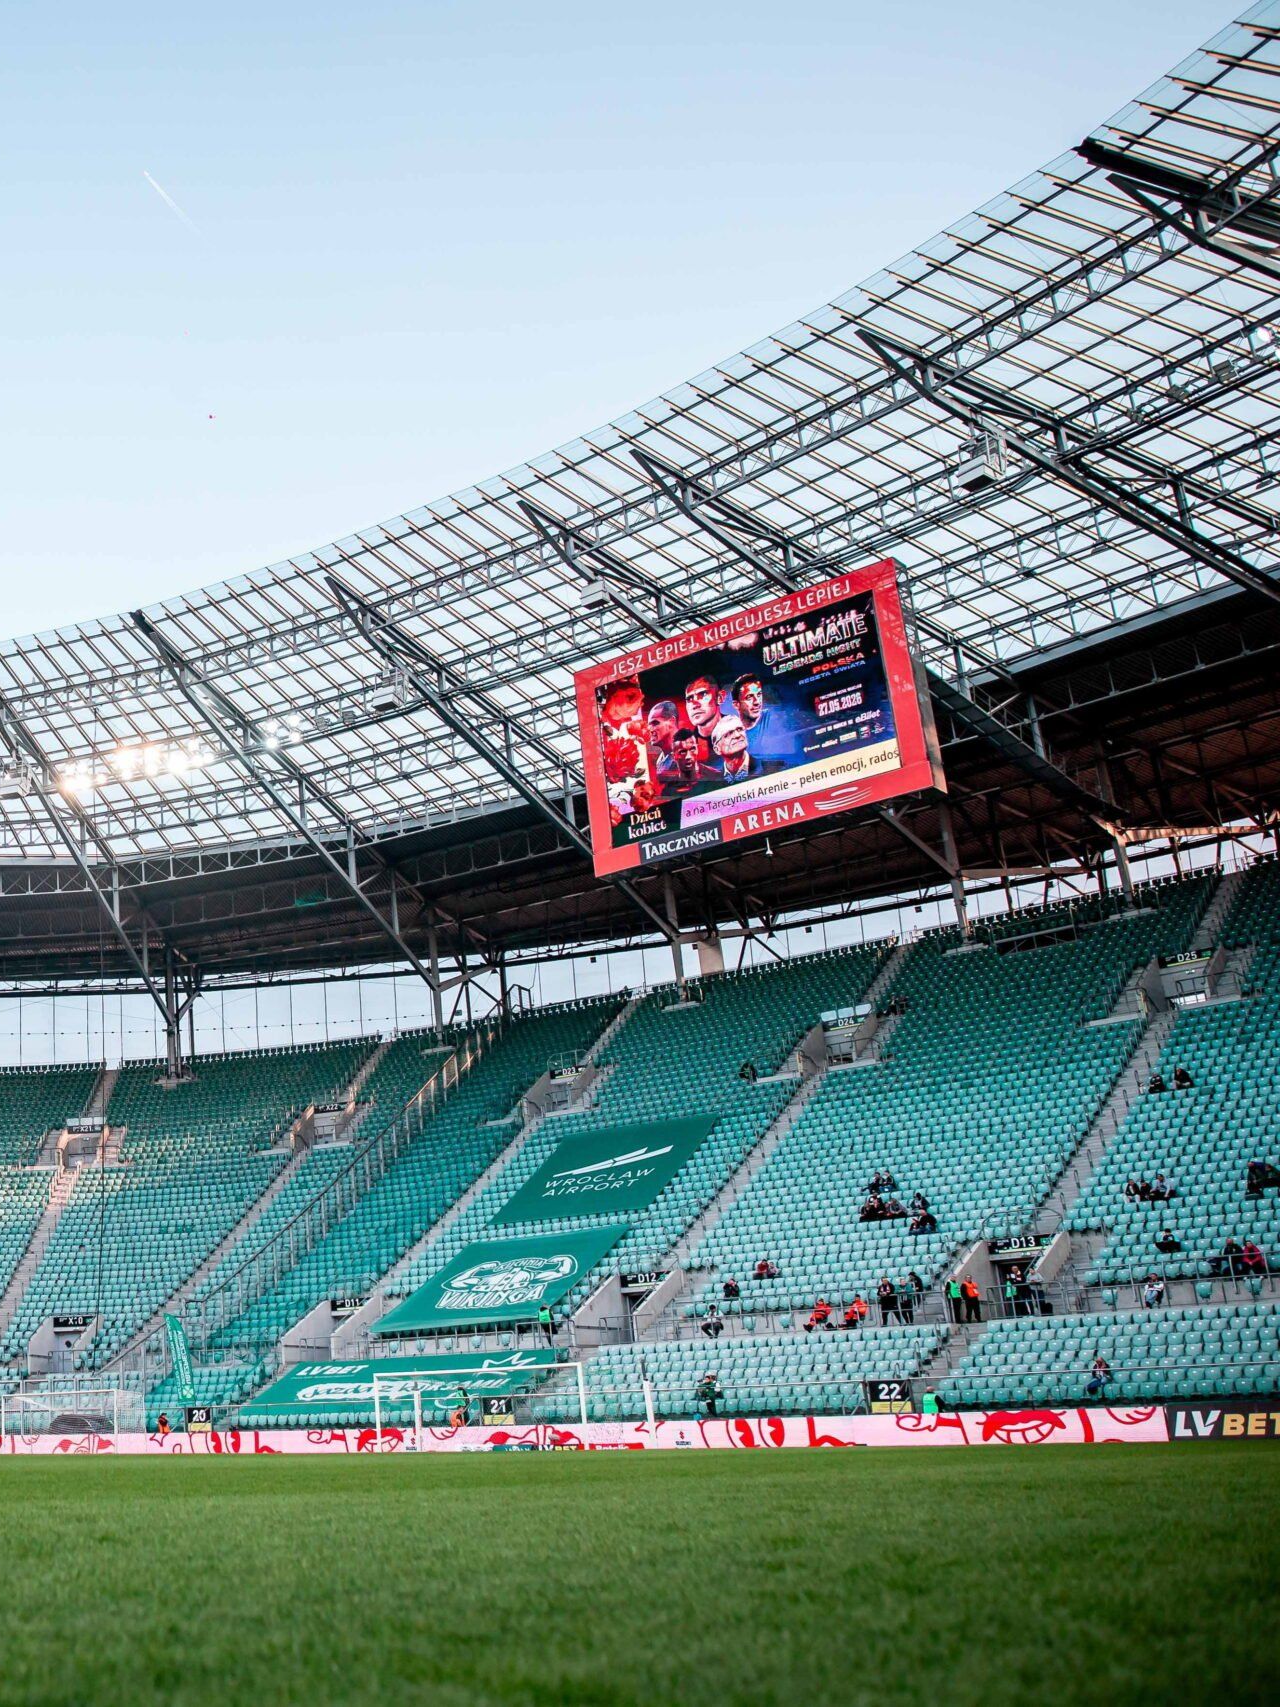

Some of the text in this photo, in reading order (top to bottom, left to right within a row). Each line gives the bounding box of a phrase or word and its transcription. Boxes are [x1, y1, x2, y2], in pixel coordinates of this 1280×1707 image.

[609, 579, 851, 678] JESZ LEPIEJ, KIBICUJESZ LEPIEJ
[762, 613, 868, 666] ULTIMATE
[772, 639, 861, 675] LEGENDS NIGHT
[812, 652, 865, 673] POLSKA
[693, 805, 705, 815] na
[706, 788, 756, 812] Tarczyński
[757, 781, 790, 799] Arenie
[799, 770, 828, 788] pełen
[830, 758, 868, 779] emocji,
[642, 801, 806, 860] TARCZYŃSKI ARENA
[1176, 951, 1197, 963] D25
[838, 1017, 854, 1027] D24
[562, 1066, 576, 1076] D23
[542, 1179, 639, 1197] AIRPORT
[1010, 1236, 1036, 1249] D13
[637, 1272, 657, 1283] D12
[344, 1298, 360, 1308] D11
[878, 1383, 902, 1400] 22
[489, 1399, 507, 1413] 21
[192, 1409, 206, 1422] 20
